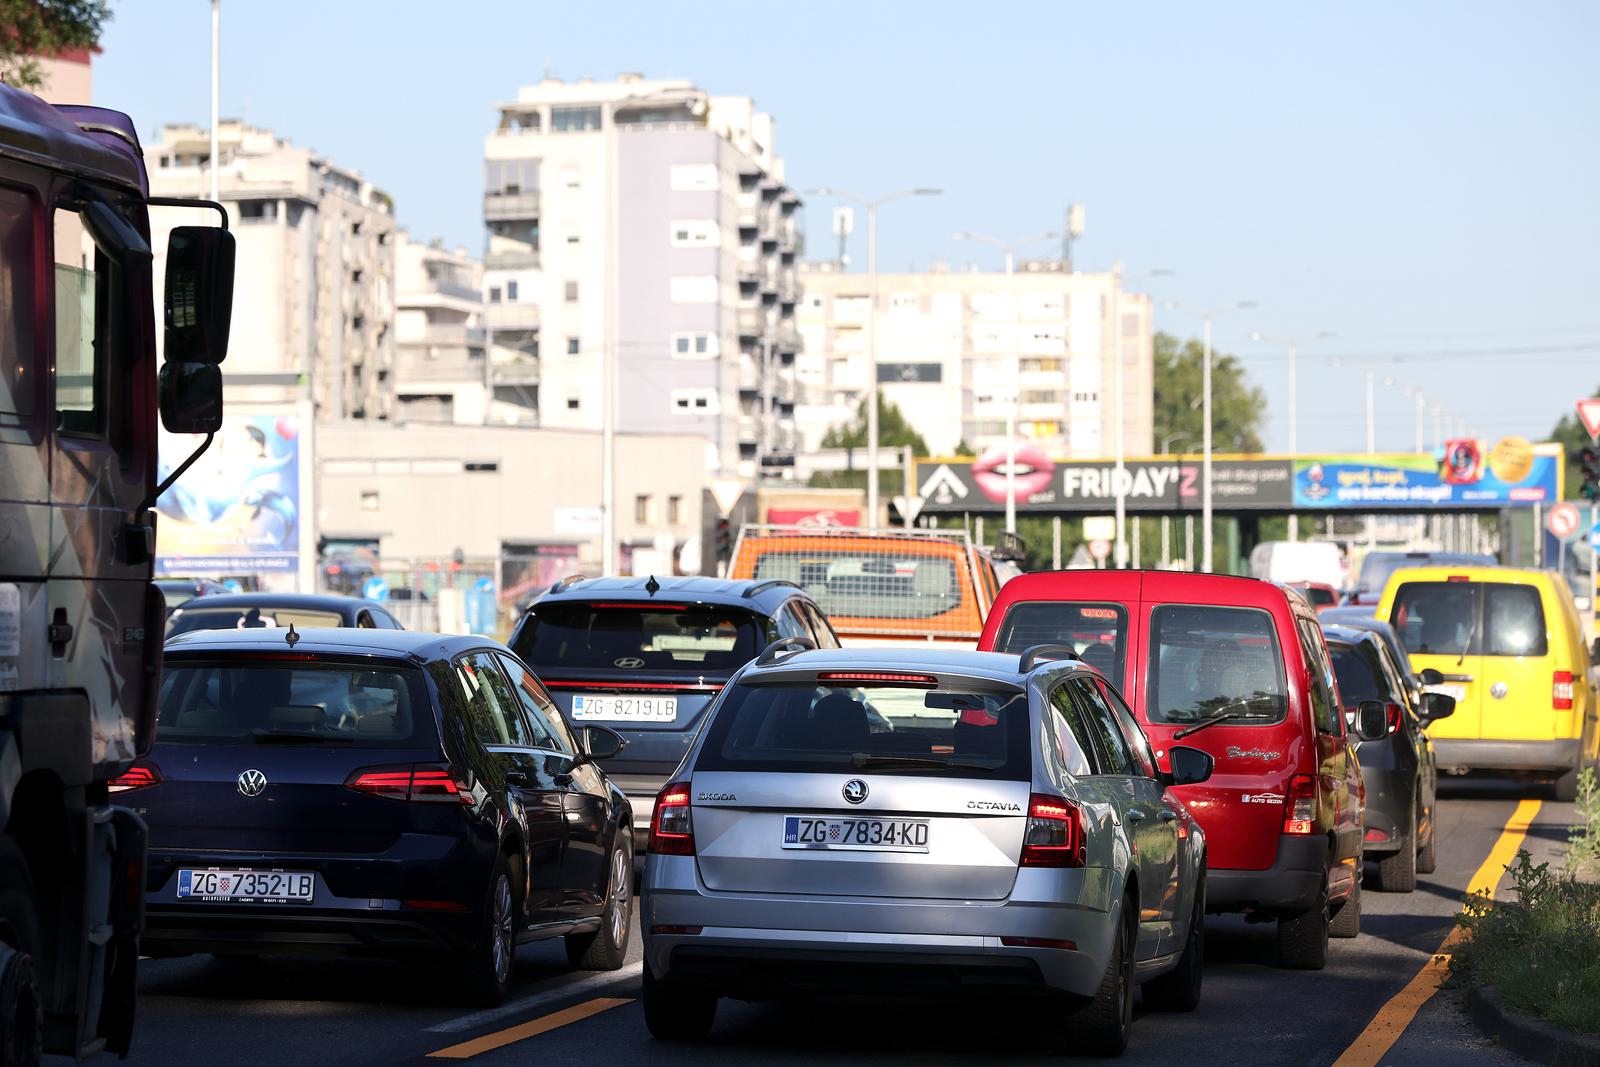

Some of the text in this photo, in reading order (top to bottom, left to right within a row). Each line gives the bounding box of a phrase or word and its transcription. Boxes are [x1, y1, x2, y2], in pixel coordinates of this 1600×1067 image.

[1063, 467, 1198, 498] FRIDAY'Z
[584, 699, 603, 715] ZG
[967, 801, 1021, 811] OCTAVIA
[800, 820, 827, 843] ZG
[192, 873, 218, 894] ZG
